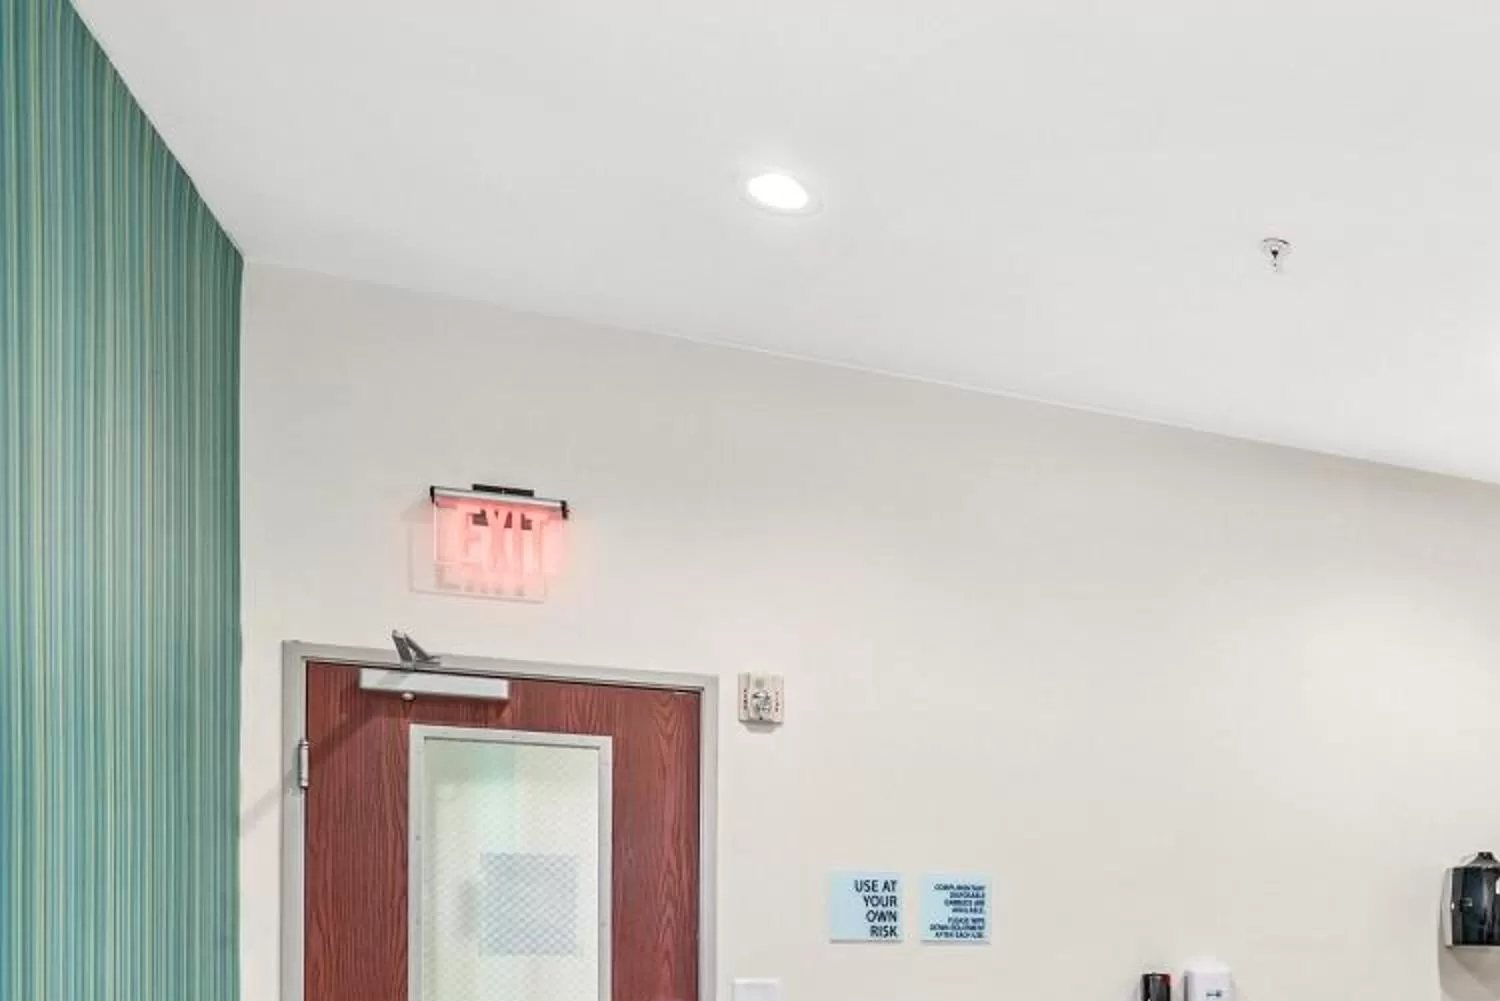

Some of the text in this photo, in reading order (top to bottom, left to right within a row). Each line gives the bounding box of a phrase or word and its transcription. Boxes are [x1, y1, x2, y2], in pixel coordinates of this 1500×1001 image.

[854, 879, 898, 893] USE AT
[863, 895, 898, 908] YOUR
[866, 910, 898, 923] OWN
[870, 925, 898, 938] RISK
